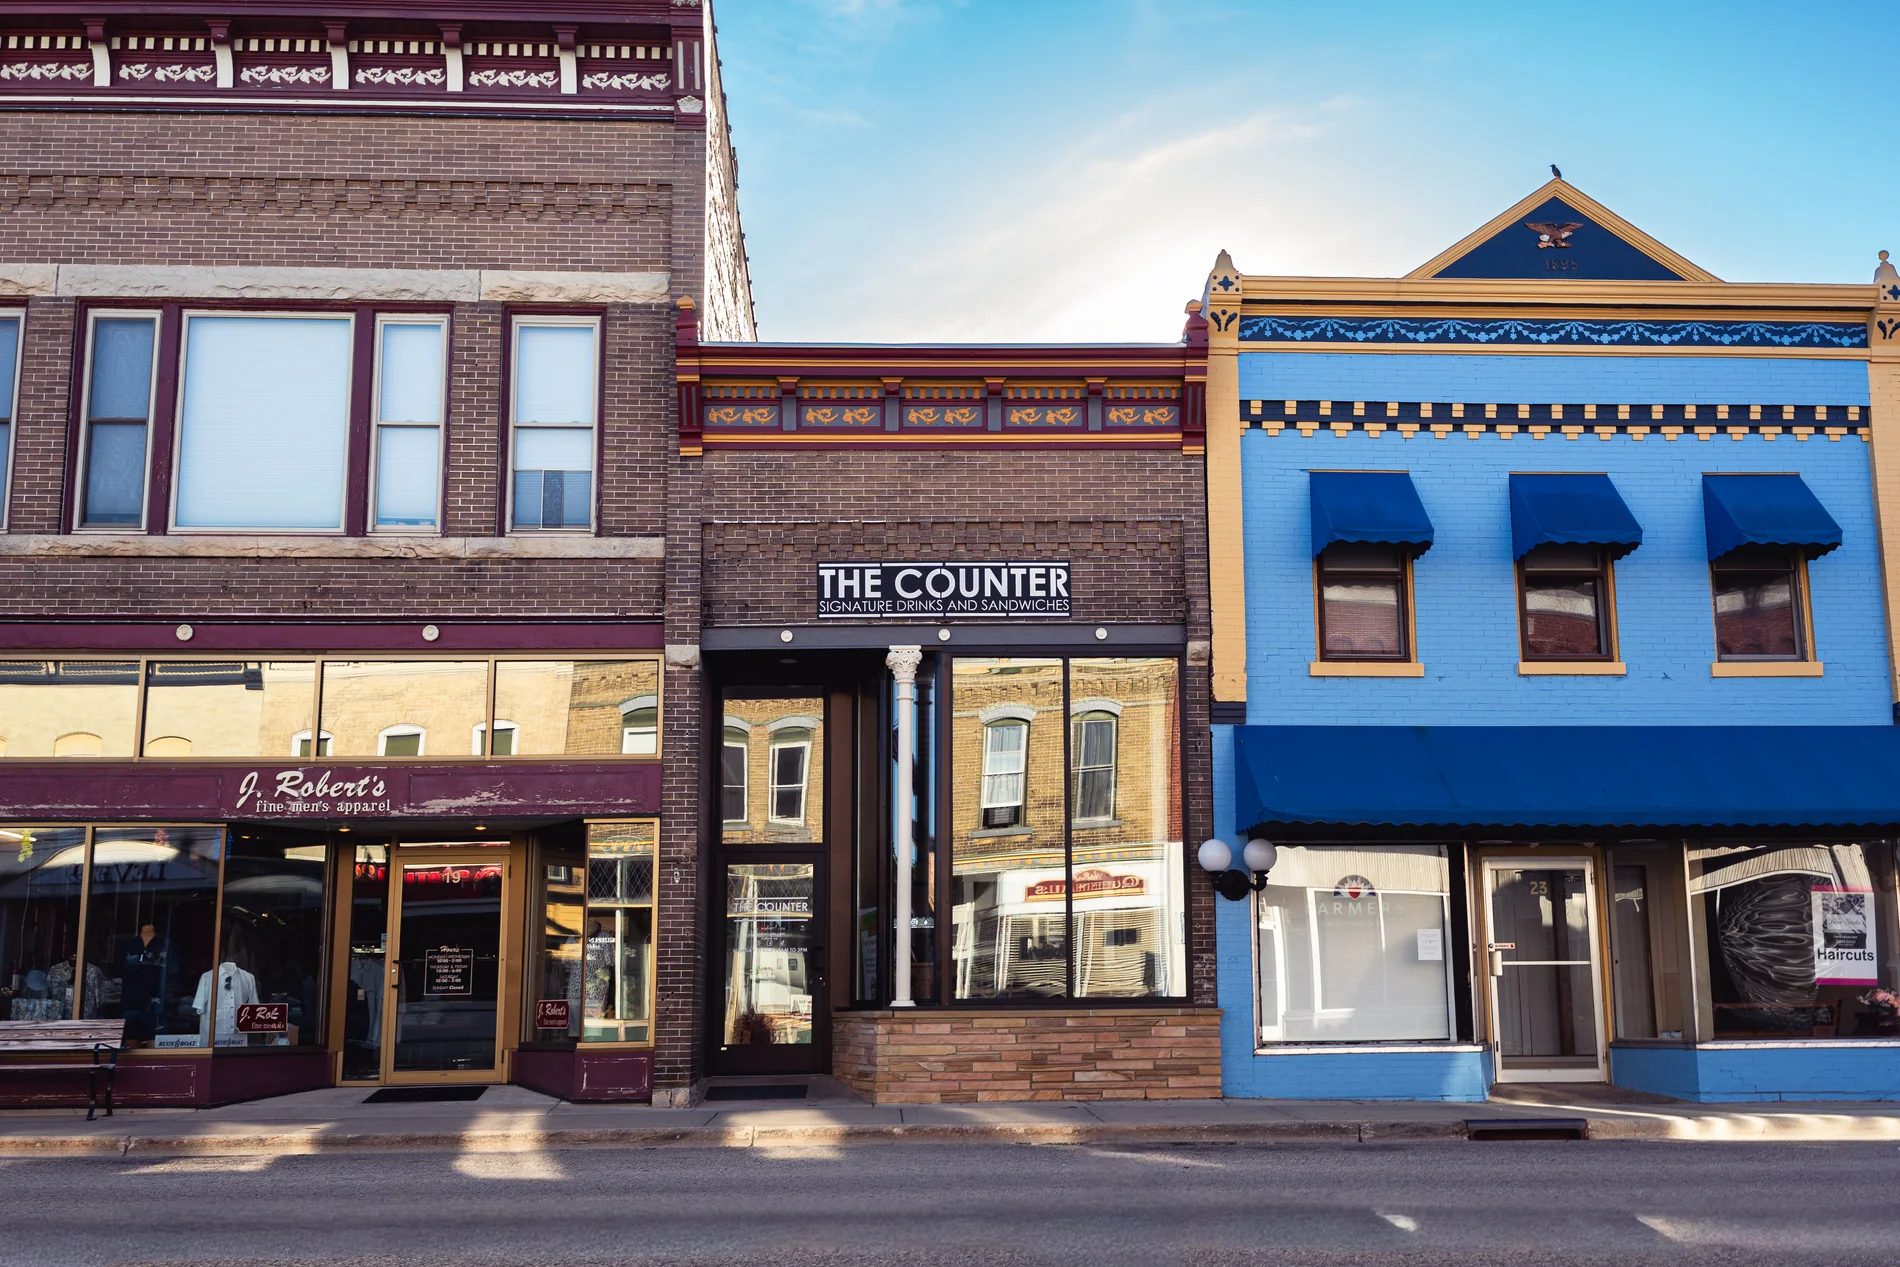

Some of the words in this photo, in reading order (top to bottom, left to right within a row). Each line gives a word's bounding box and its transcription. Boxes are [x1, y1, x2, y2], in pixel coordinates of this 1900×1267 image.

[819, 568, 882, 599] THE
[894, 568, 1069, 599] COUNTER
[819, 601, 893, 613] SIGNATURE
[897, 600, 943, 612] DRINKS
[947, 599, 978, 611] AND
[981, 599, 1070, 611] SANDWICHES
[236, 771, 262, 809] J.
[274, 770, 387, 798] Robert's
[255, 800, 284, 813] fine
[291, 801, 329, 812] men's
[336, 799, 390, 815] apparel
[443, 872, 461, 884] 19
[1530, 881, 1548, 895] 23
[734, 902, 753, 912] THE
[757, 901, 808, 912] COUNTER
[1307, 902, 1405, 915] ARMERS
[1817, 948, 1874, 961] Haircuts
[239, 1006, 251, 1024] J.
[545, 1003, 567, 1016] Robert's
